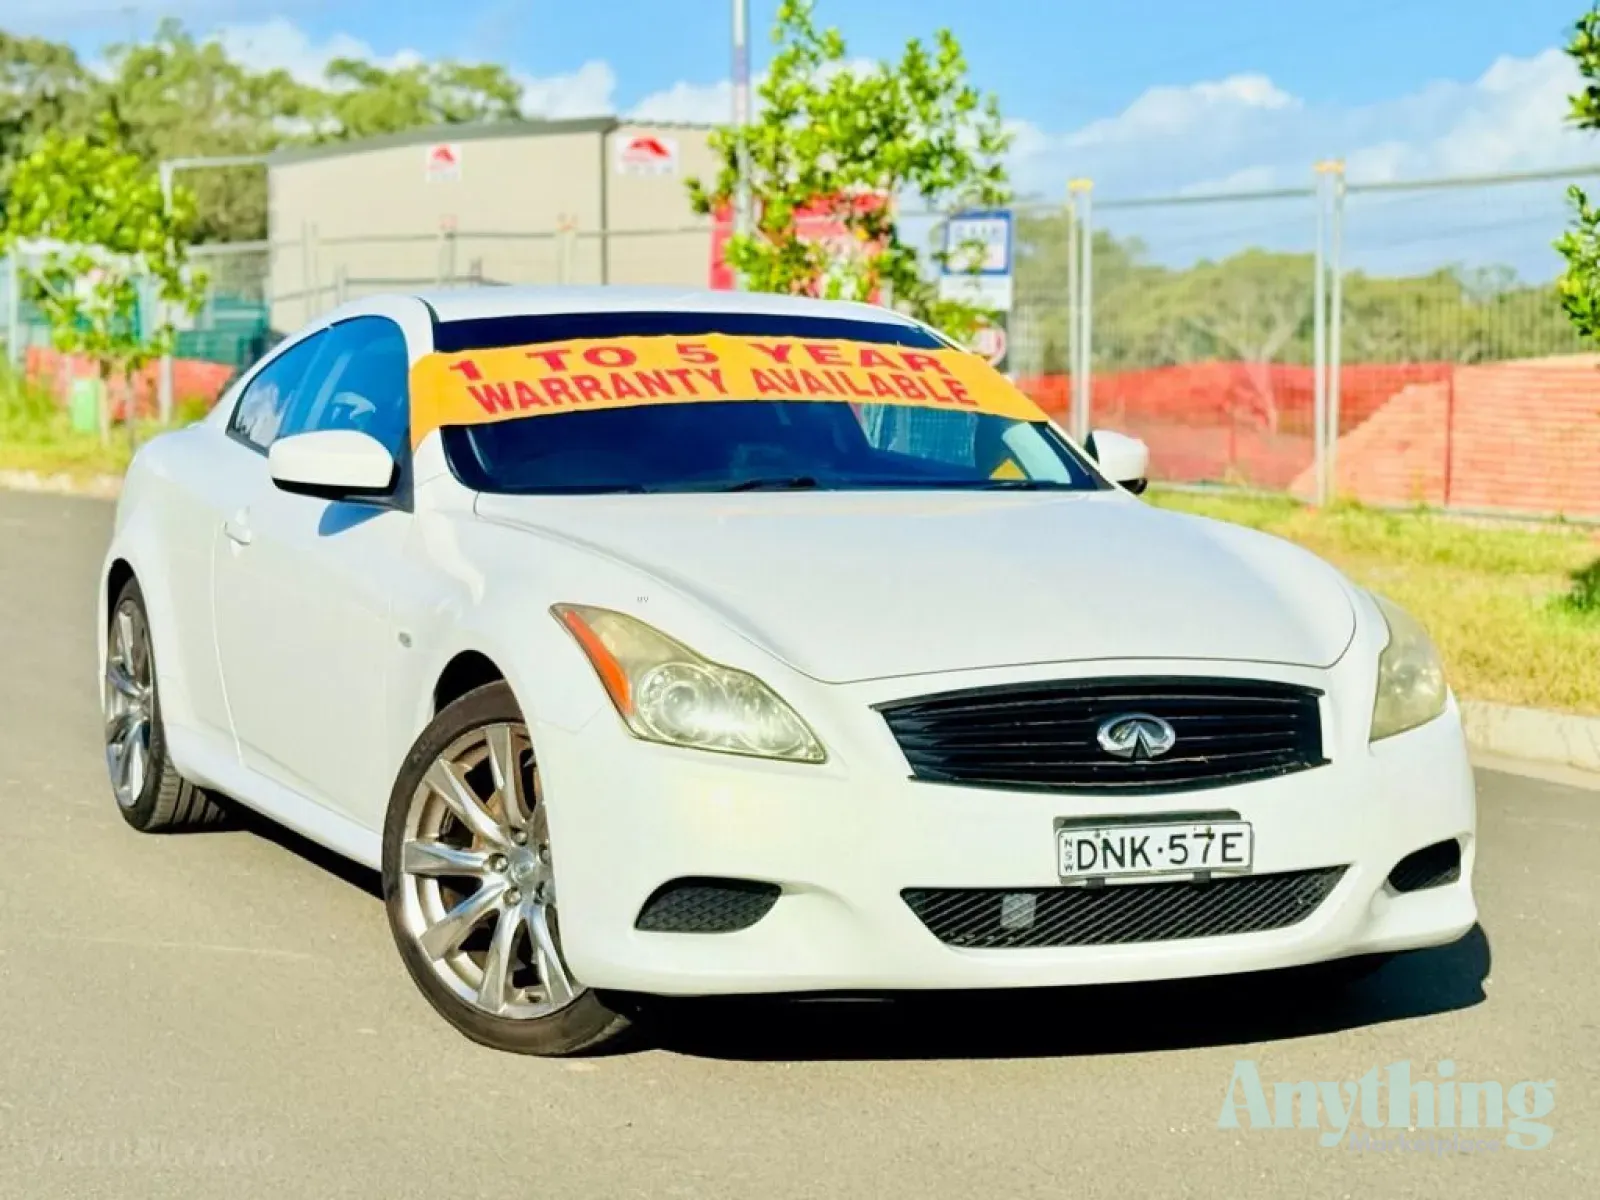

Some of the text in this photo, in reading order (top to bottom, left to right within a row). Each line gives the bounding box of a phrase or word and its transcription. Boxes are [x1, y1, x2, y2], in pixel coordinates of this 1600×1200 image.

[449, 343, 952, 381] 1 TO 5 YEAR
[467, 367, 978, 414] WARRANTY AVAILABLE
